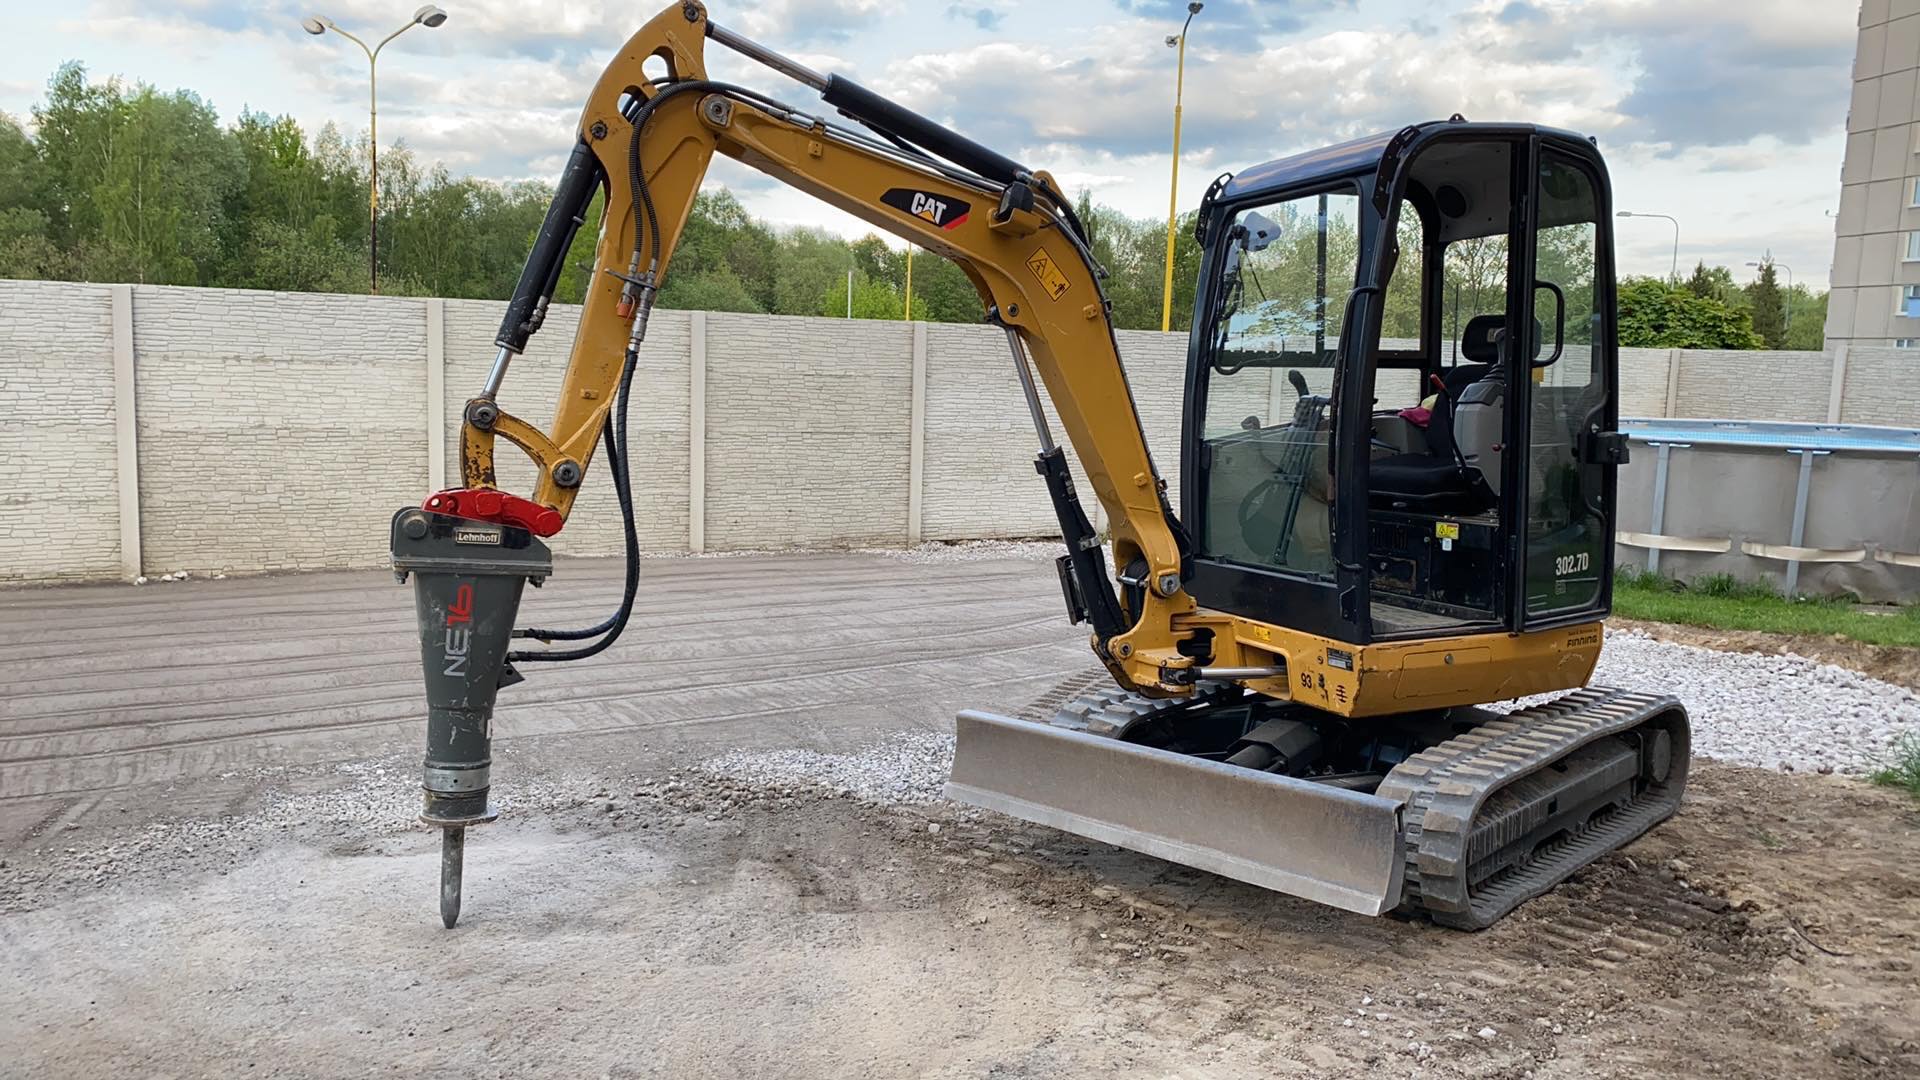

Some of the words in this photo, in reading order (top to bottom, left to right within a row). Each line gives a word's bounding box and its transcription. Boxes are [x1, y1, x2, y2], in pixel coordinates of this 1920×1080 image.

[911, 193, 946, 224] CAT
[458, 532, 498, 543] Lehnhoff
[1555, 552, 1589, 576] 302.7D
[1301, 672, 1312, 688] 93
